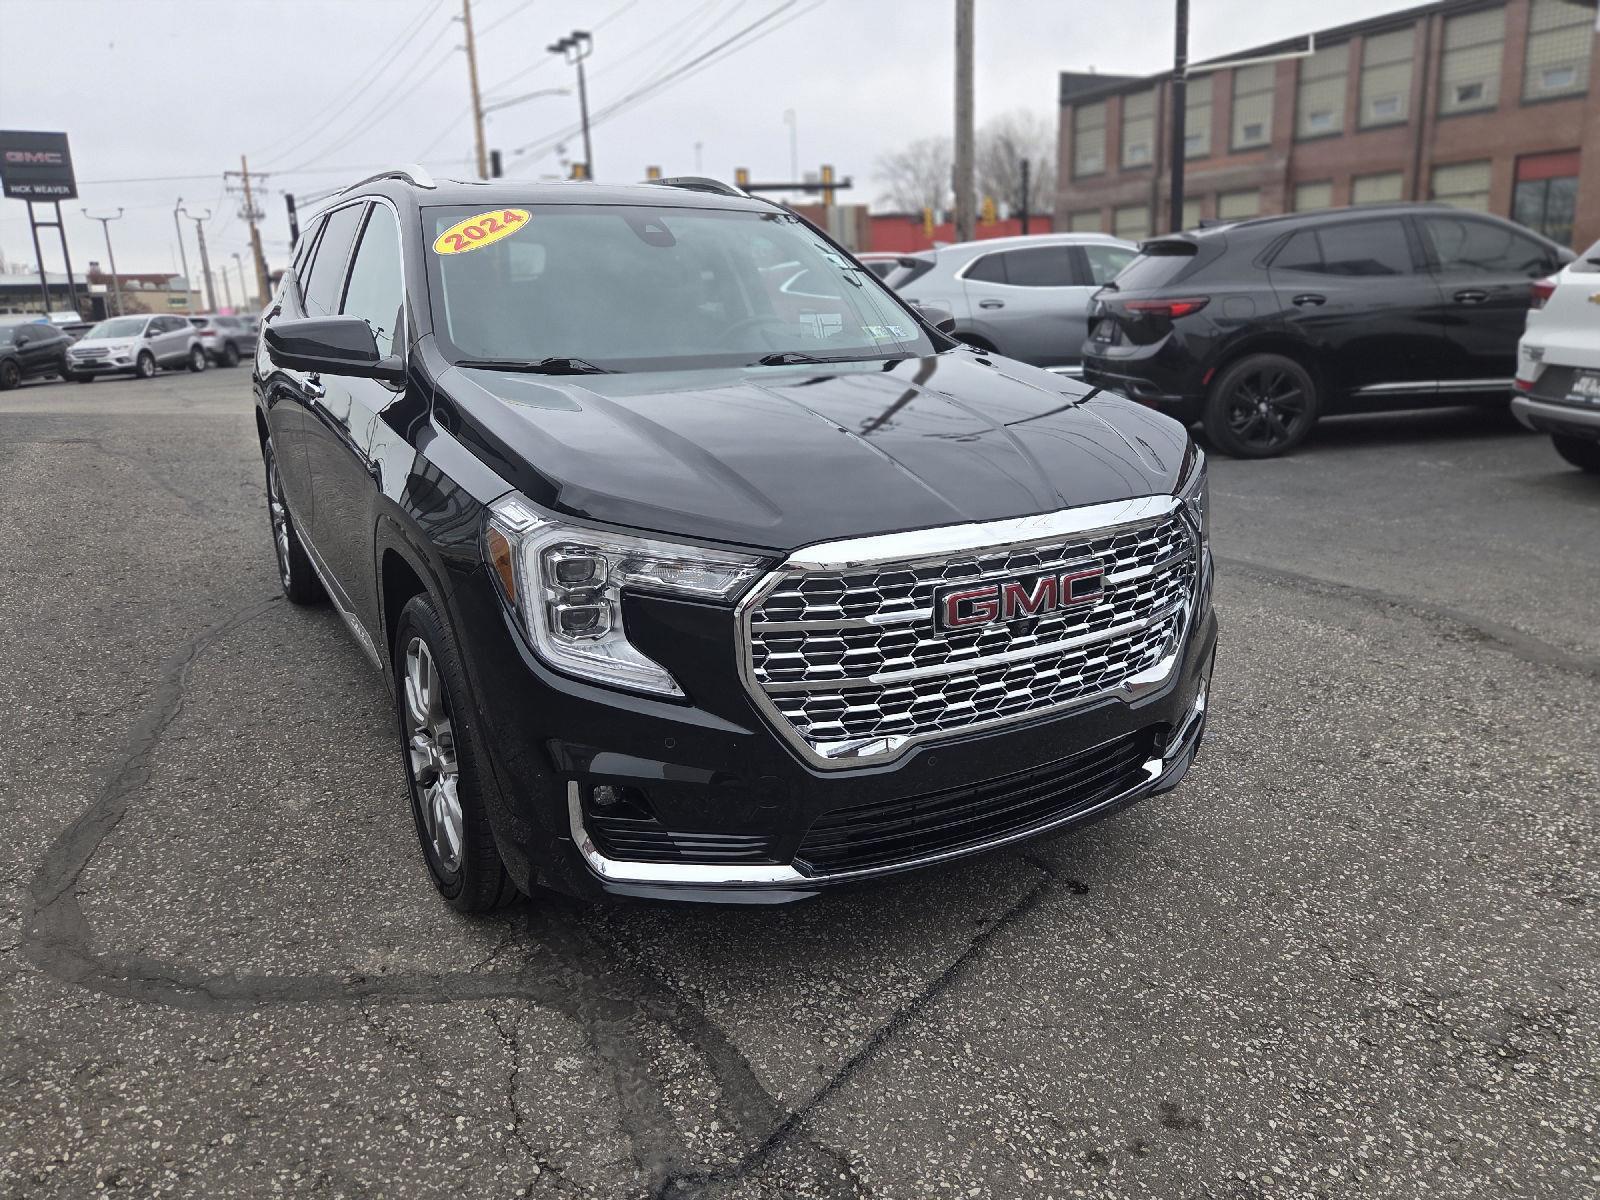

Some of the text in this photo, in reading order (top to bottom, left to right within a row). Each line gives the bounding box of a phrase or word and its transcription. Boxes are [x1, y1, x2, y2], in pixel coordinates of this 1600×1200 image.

[5, 151, 62, 164] GMC
[444, 210, 524, 252] 2024
[942, 567, 1105, 628] GMC
